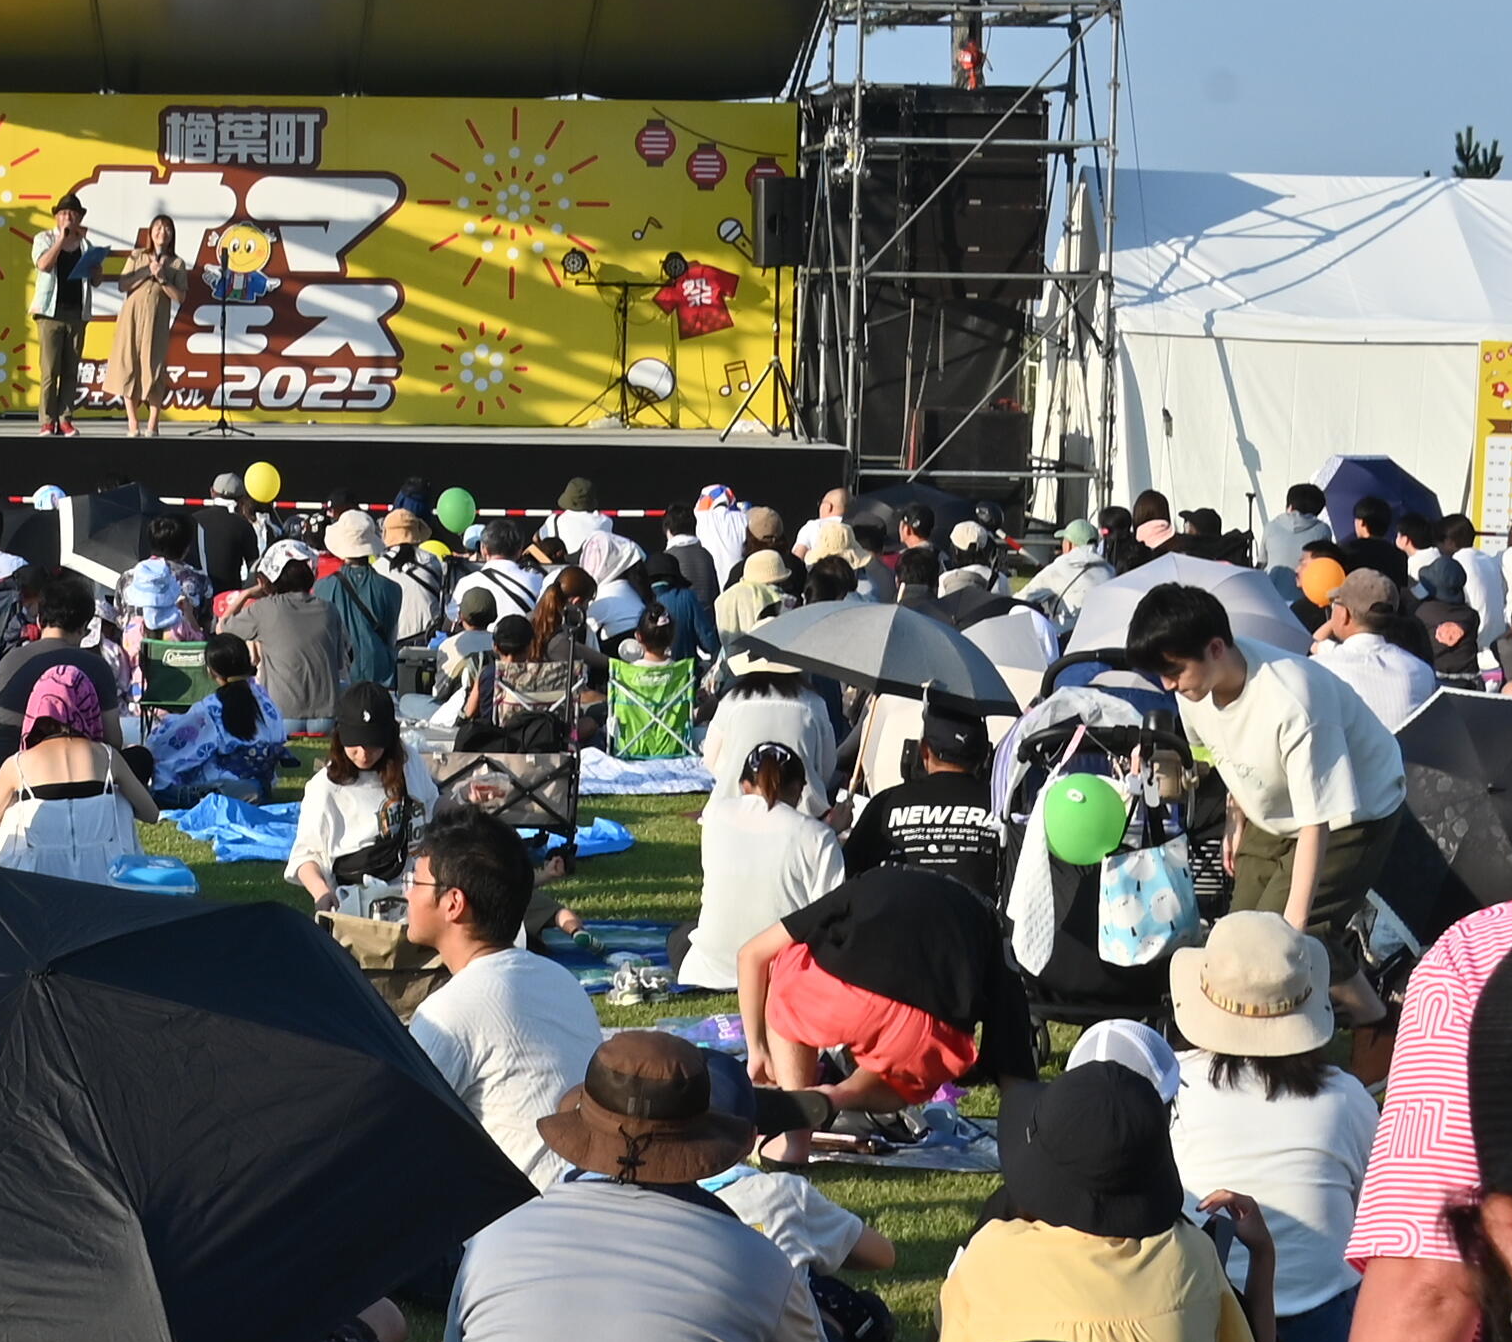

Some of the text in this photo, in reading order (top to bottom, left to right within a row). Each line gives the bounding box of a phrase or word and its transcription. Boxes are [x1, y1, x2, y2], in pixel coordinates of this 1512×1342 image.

[164, 111, 320, 165] 楢葉町
[211, 366, 399, 409] 2025
[888, 805, 952, 829] NEW
